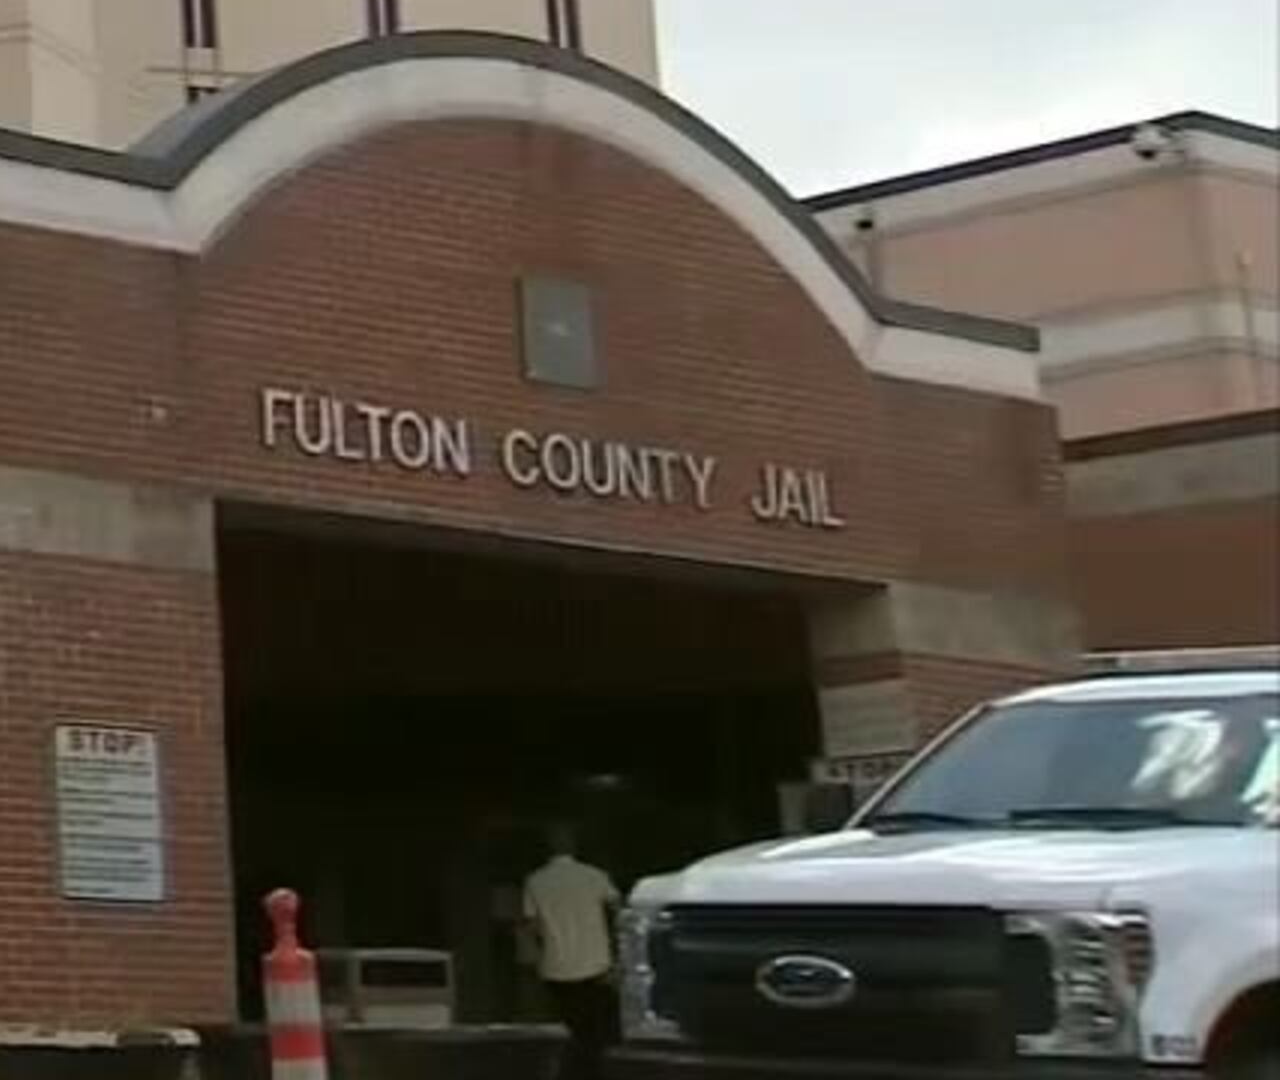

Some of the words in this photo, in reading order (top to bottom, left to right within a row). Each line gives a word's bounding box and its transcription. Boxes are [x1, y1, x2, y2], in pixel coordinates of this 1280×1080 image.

[263, 388, 470, 474] FULTON
[503, 428, 715, 509] COUNTY
[751, 463, 845, 526] JAIL
